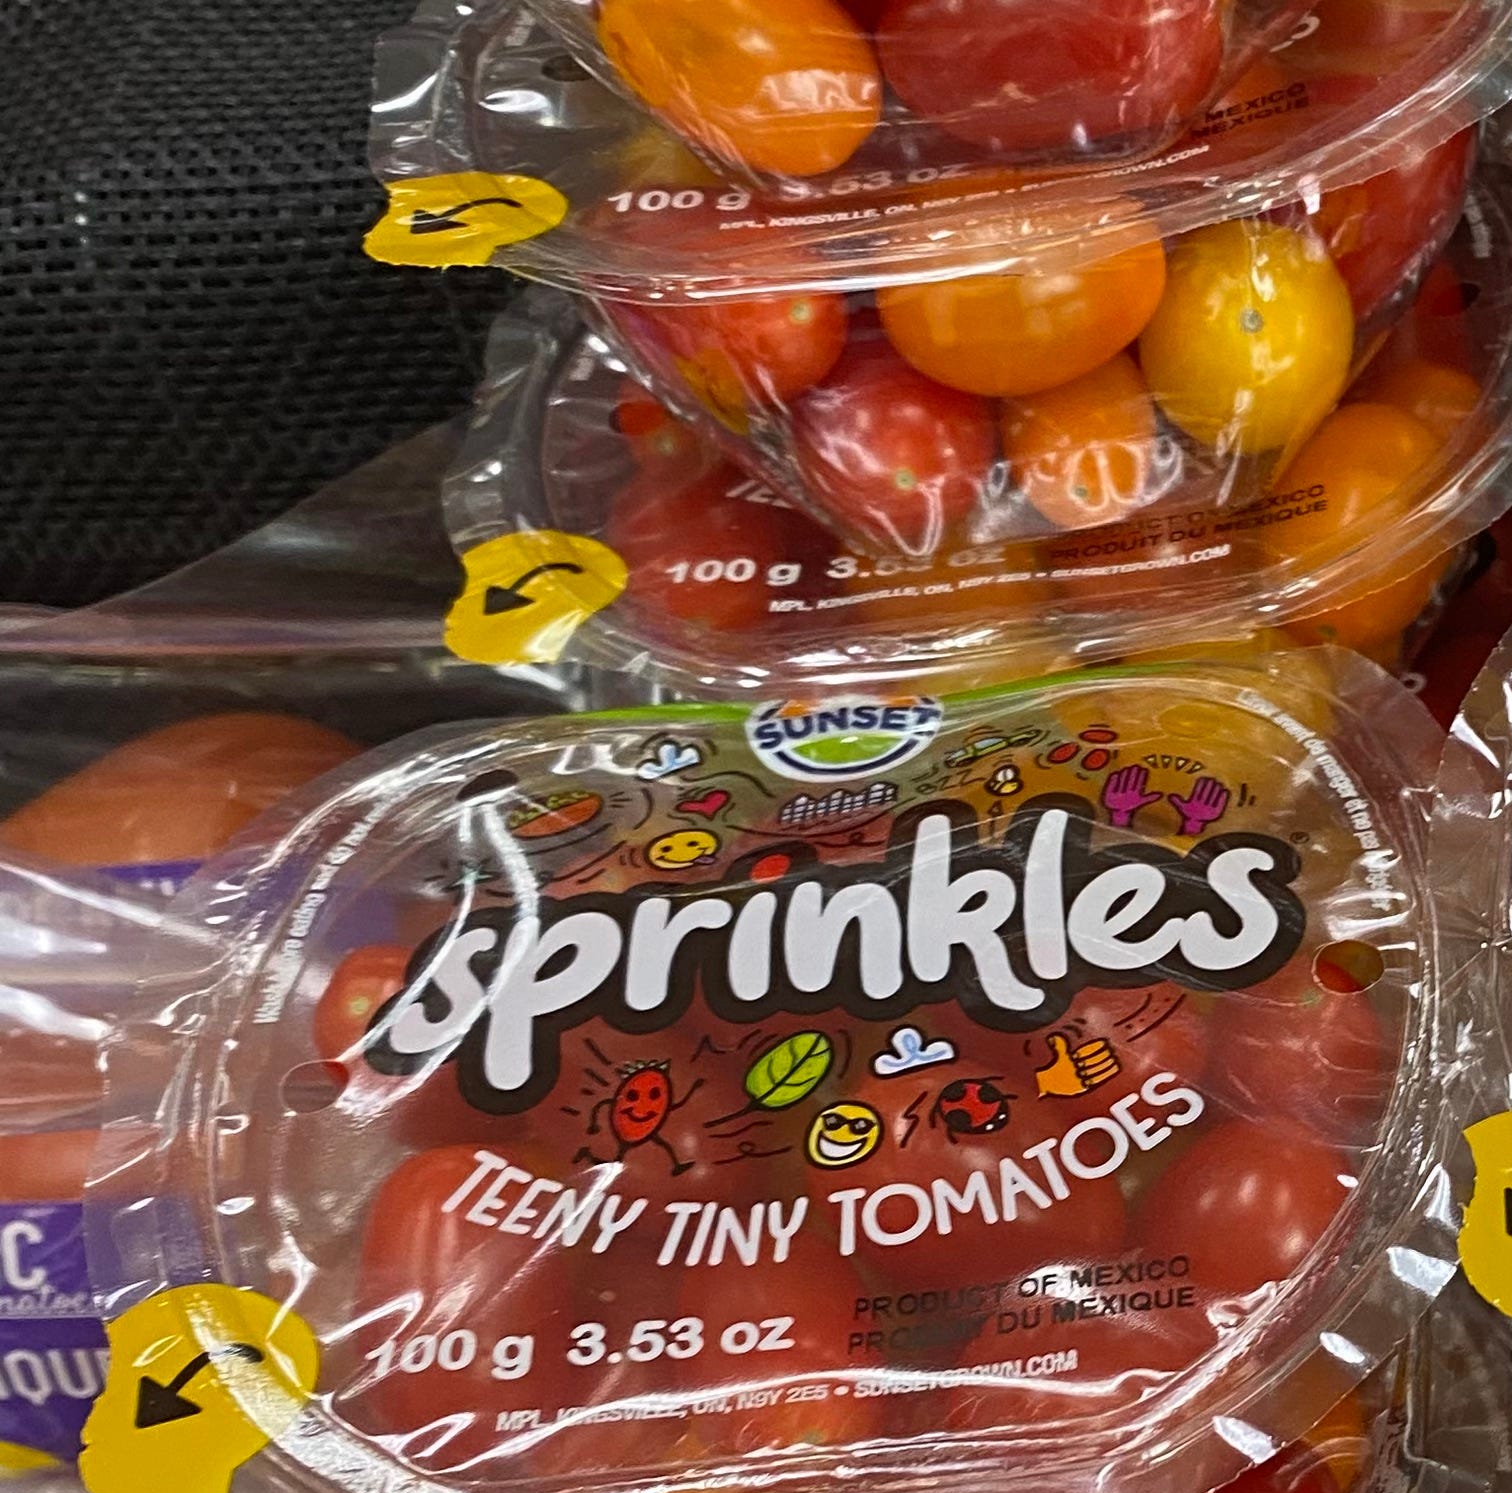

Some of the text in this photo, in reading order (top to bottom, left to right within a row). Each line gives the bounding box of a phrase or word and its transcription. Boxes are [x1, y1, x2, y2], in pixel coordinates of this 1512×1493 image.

[608, 190, 704, 213] 100
[665, 558, 757, 584] 100
[766, 562, 801, 587] g
[753, 704, 941, 750] SUNSET
[387, 808, 1279, 1093] sprinkles
[442, 1070, 1206, 1267] TEENY TINY TOMATOES
[1018, 1272, 1060, 1299] OF
[1069, 1254, 1191, 1289] MEXICO
[997, 1308, 1042, 1335] DU
[365, 1315, 797, 1381] 100 g 3.53 oz
